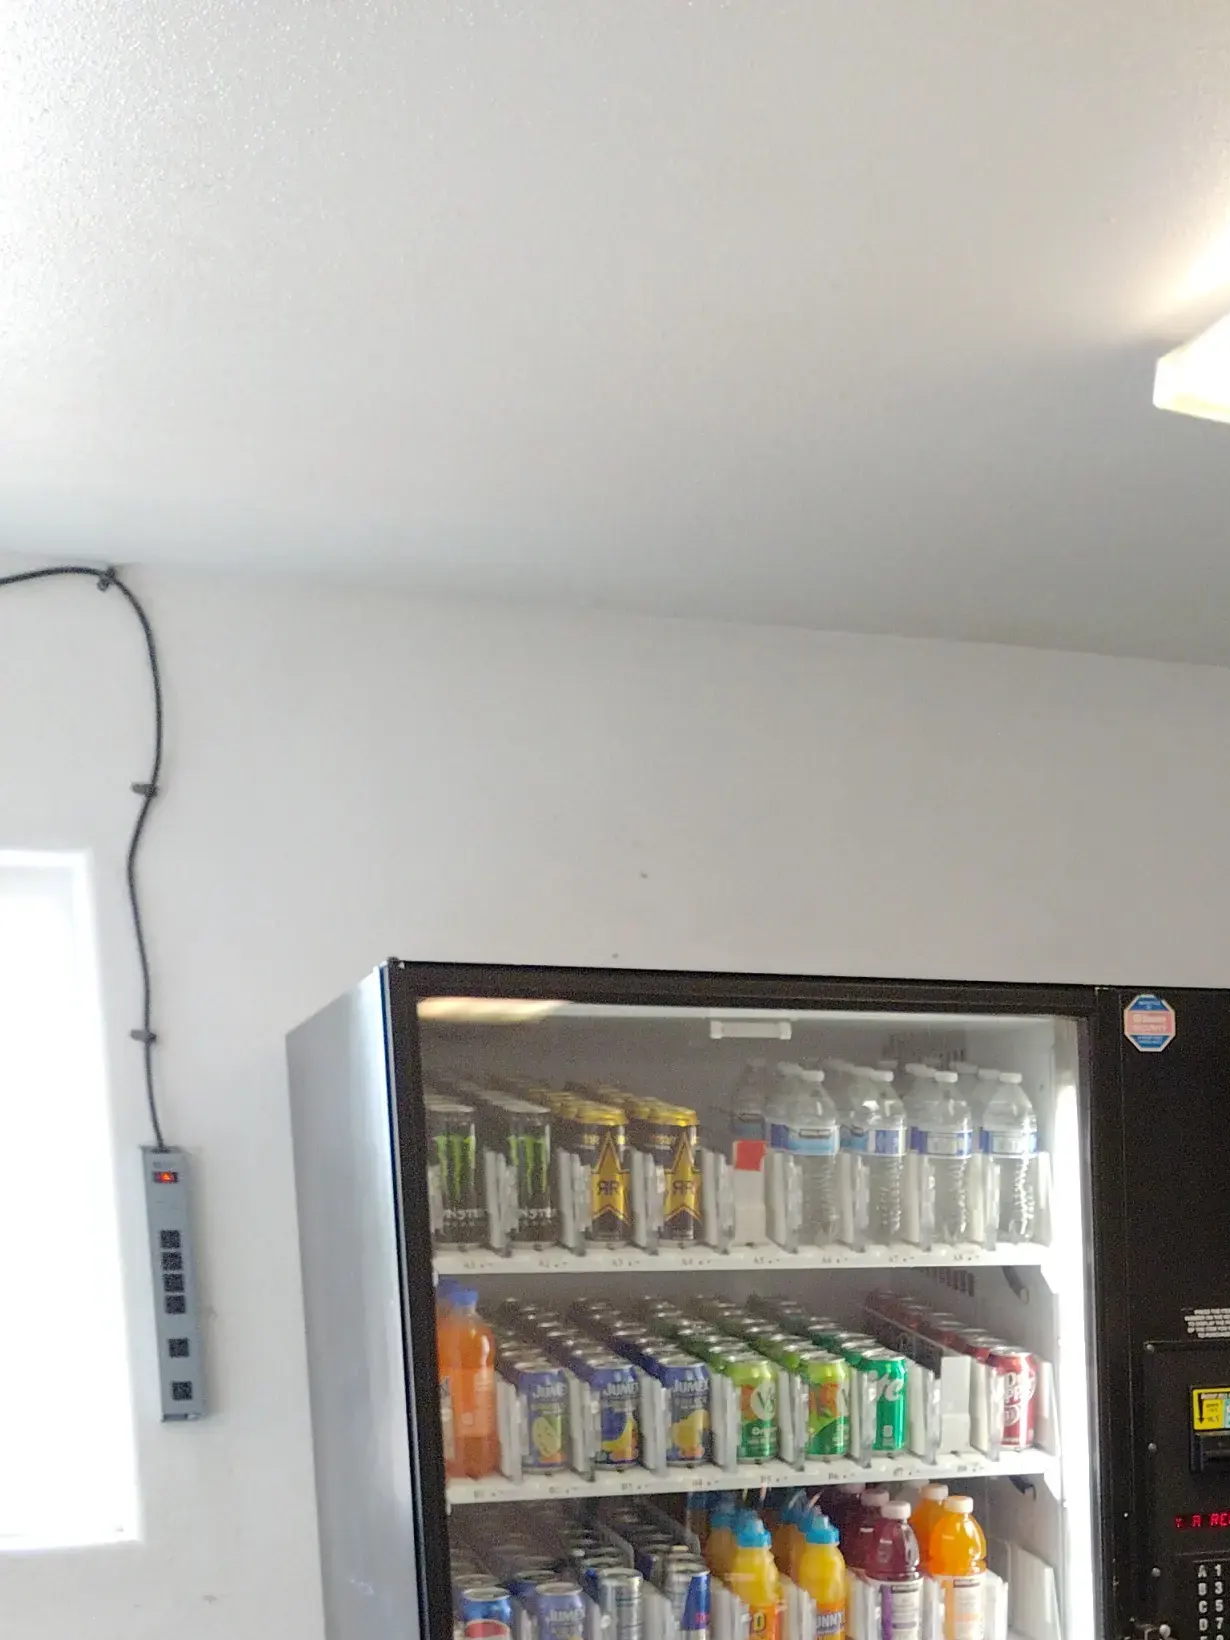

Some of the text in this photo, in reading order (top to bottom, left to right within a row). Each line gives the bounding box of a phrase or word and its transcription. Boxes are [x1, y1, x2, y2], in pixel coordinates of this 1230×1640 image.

[1198, 1564, 1207, 1578] A
[1214, 1563, 1222, 1576] 1
[1214, 1581, 1223, 1595] 3
[1199, 1600, 1208, 1614] C
[1215, 1599, 1224, 1612] 5
[1215, 1617, 1224, 1630] 7
